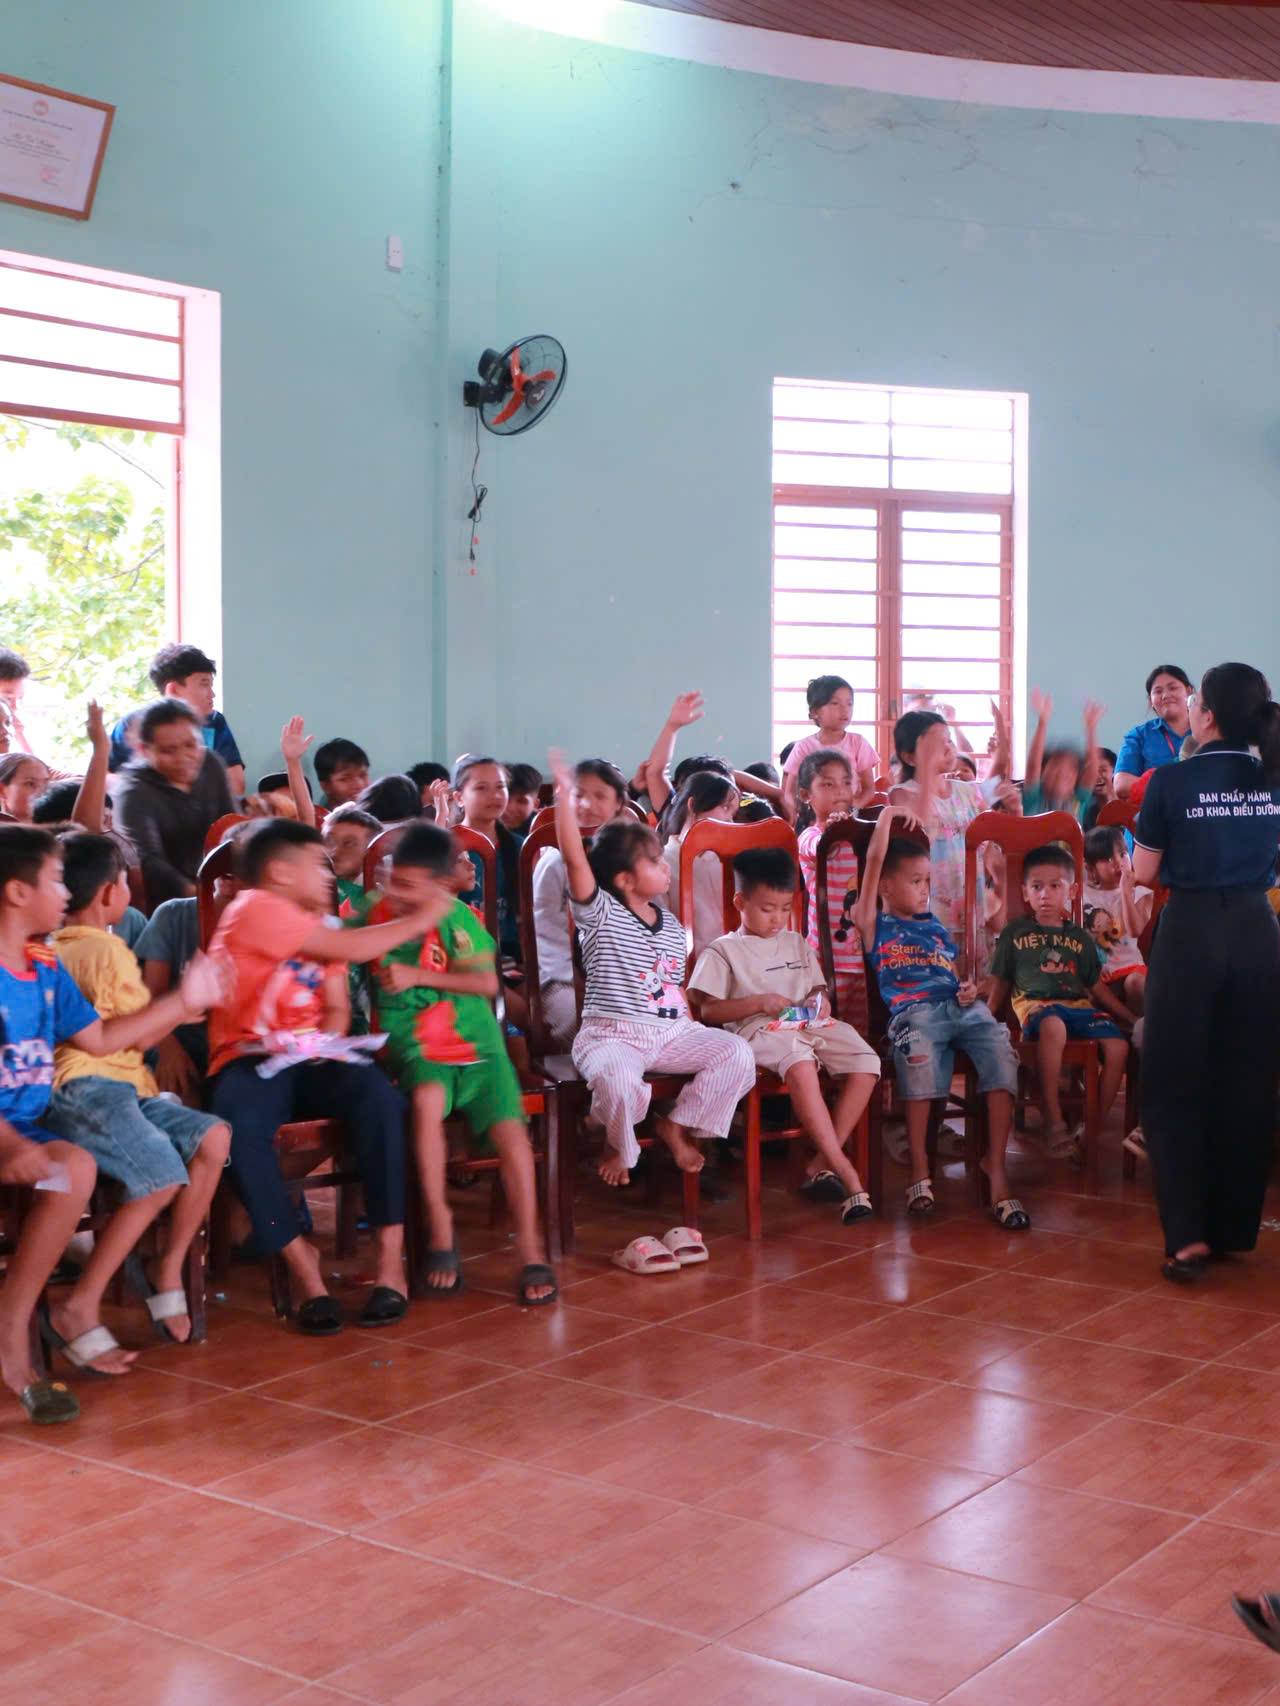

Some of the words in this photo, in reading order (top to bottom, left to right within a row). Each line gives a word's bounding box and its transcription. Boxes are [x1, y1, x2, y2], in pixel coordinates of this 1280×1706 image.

[1199, 792, 1218, 803] BAN
[1221, 788, 1245, 803] CHẤP
[1247, 790, 1271, 802] HÀNH
[1206, 806, 1231, 817] KHOA
[1013, 932, 1048, 951] VIỆT
[1053, 934, 1083, 953] NAM
